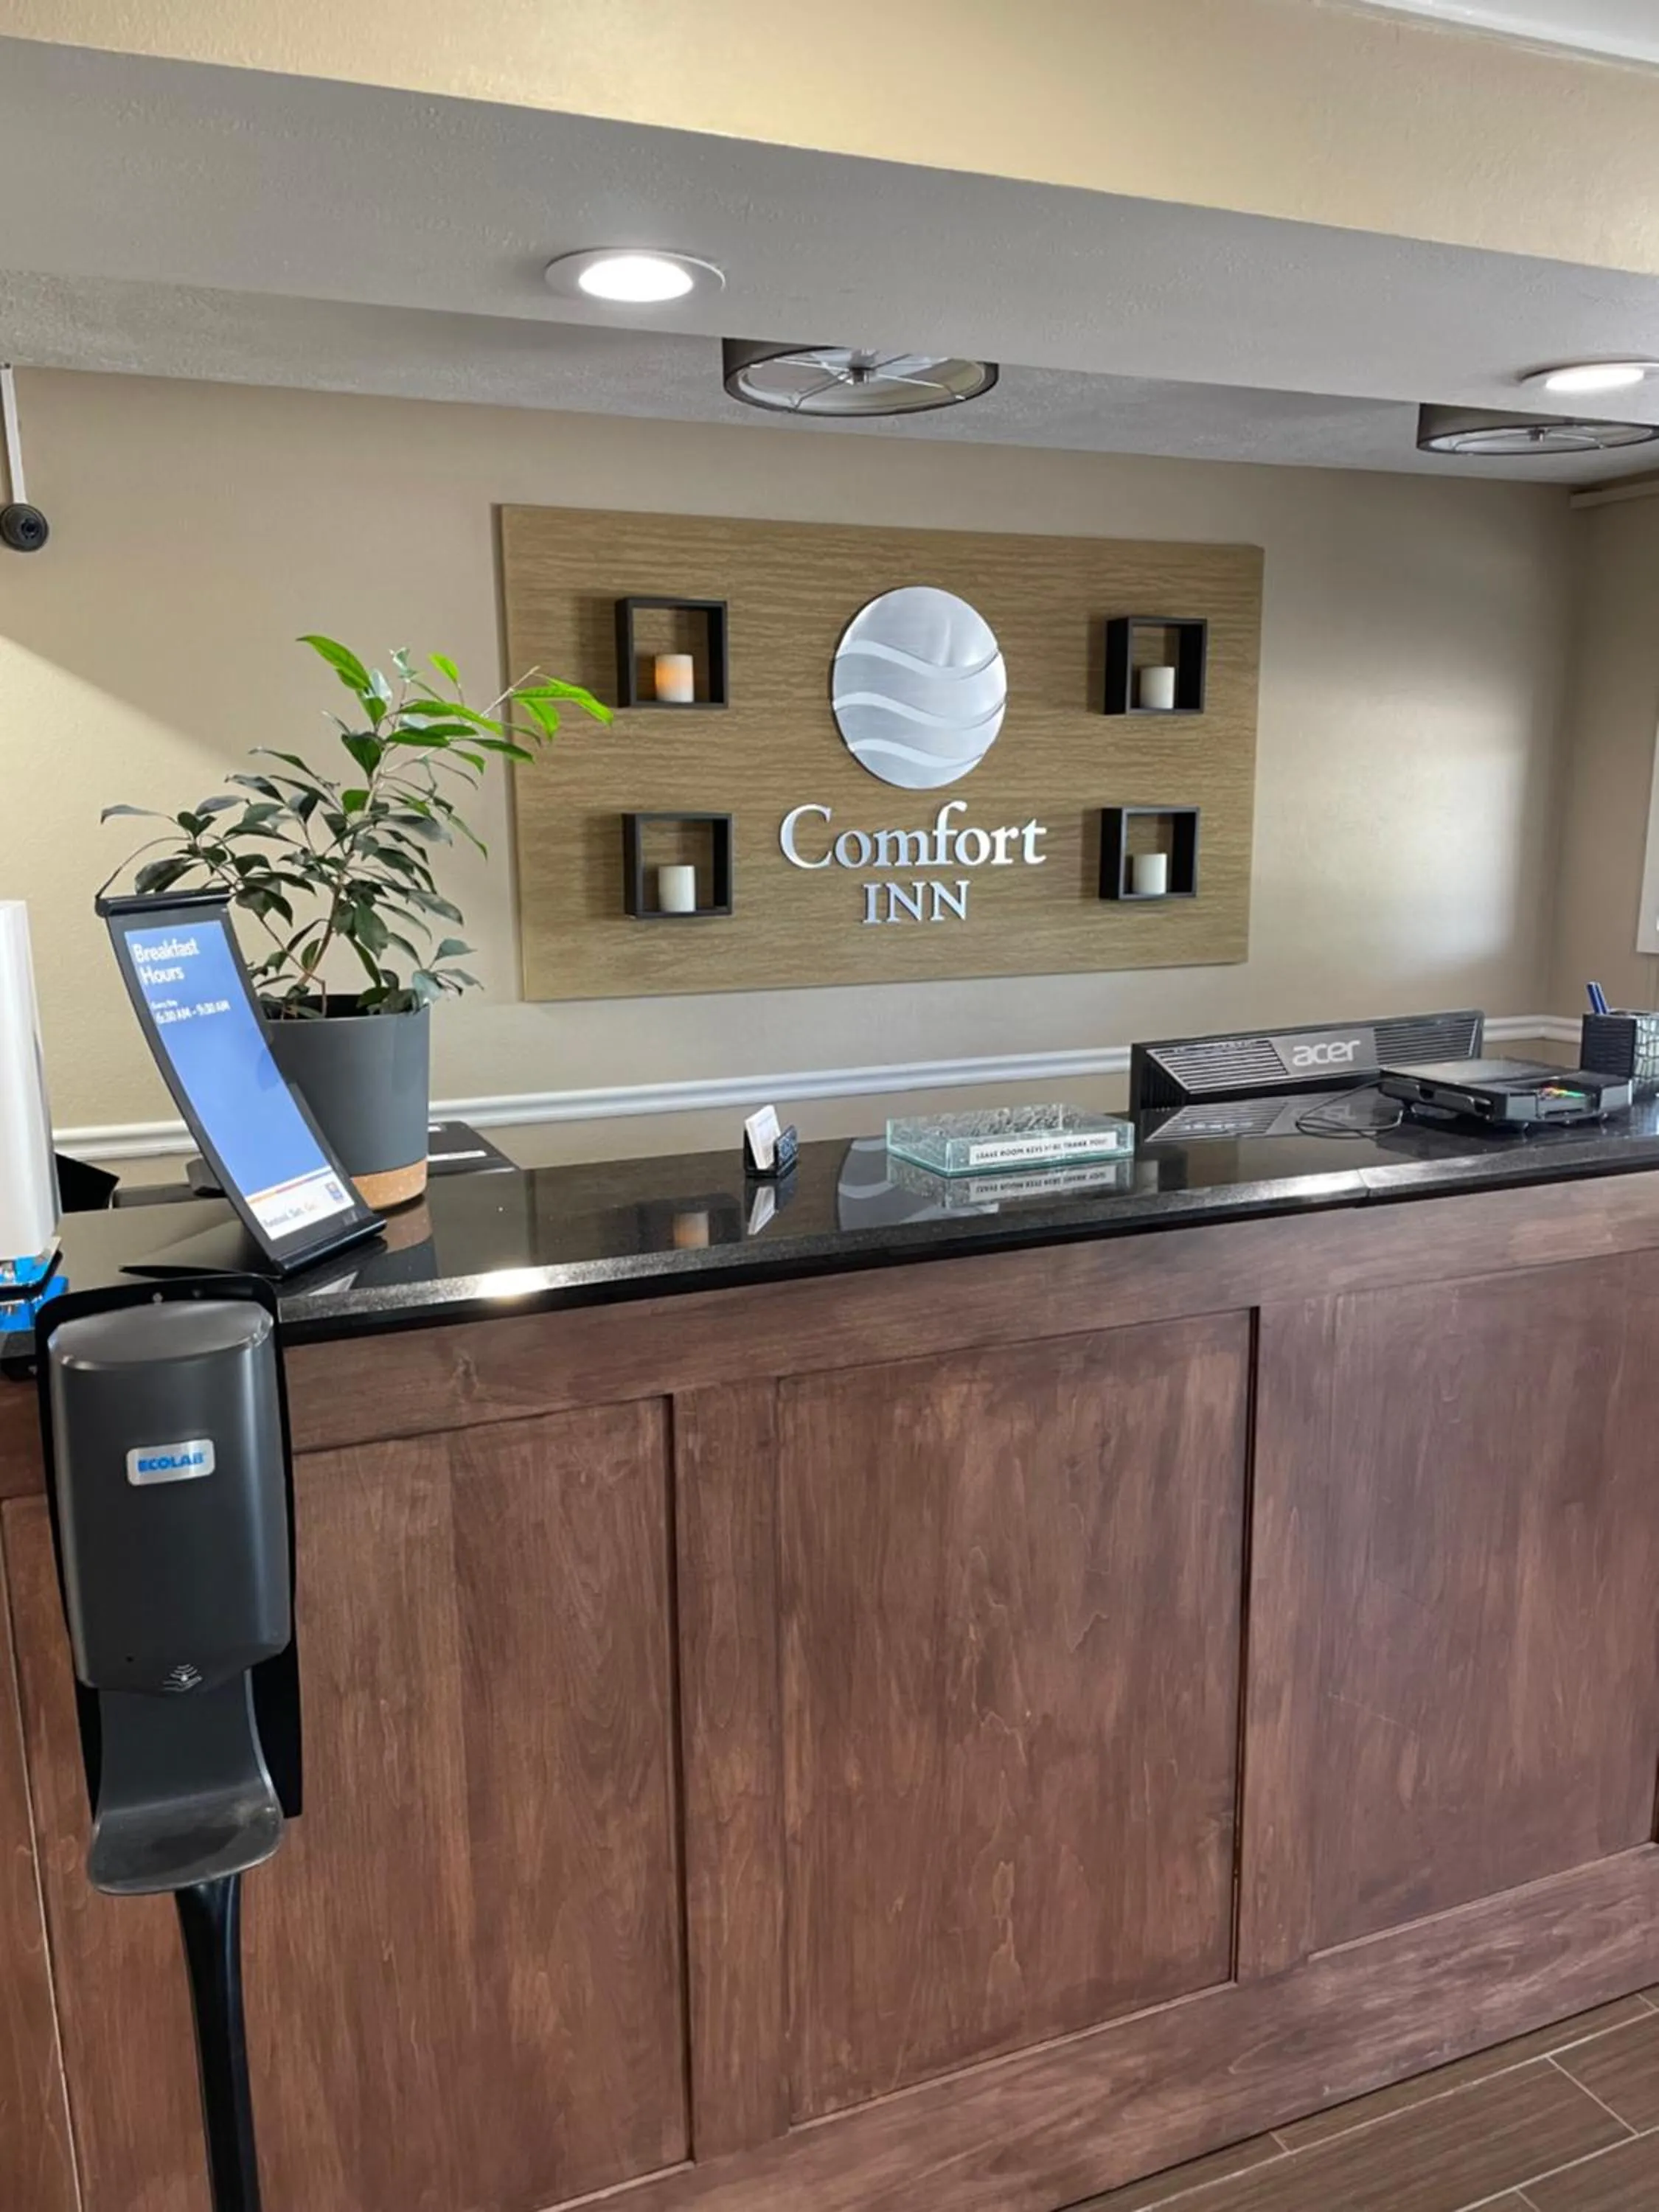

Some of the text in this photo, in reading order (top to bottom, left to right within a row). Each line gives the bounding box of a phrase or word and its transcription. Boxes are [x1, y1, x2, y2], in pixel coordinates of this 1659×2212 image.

[779, 801, 1048, 869] Comfort
[862, 880, 971, 924] INN
[132, 937, 200, 963] Breakfast
[139, 966, 184, 985] Hours
[1292, 1040, 1361, 1066] acer
[1000, 1148, 1024, 1156] ROOM
[138, 1452, 204, 1473] ECOLAB
